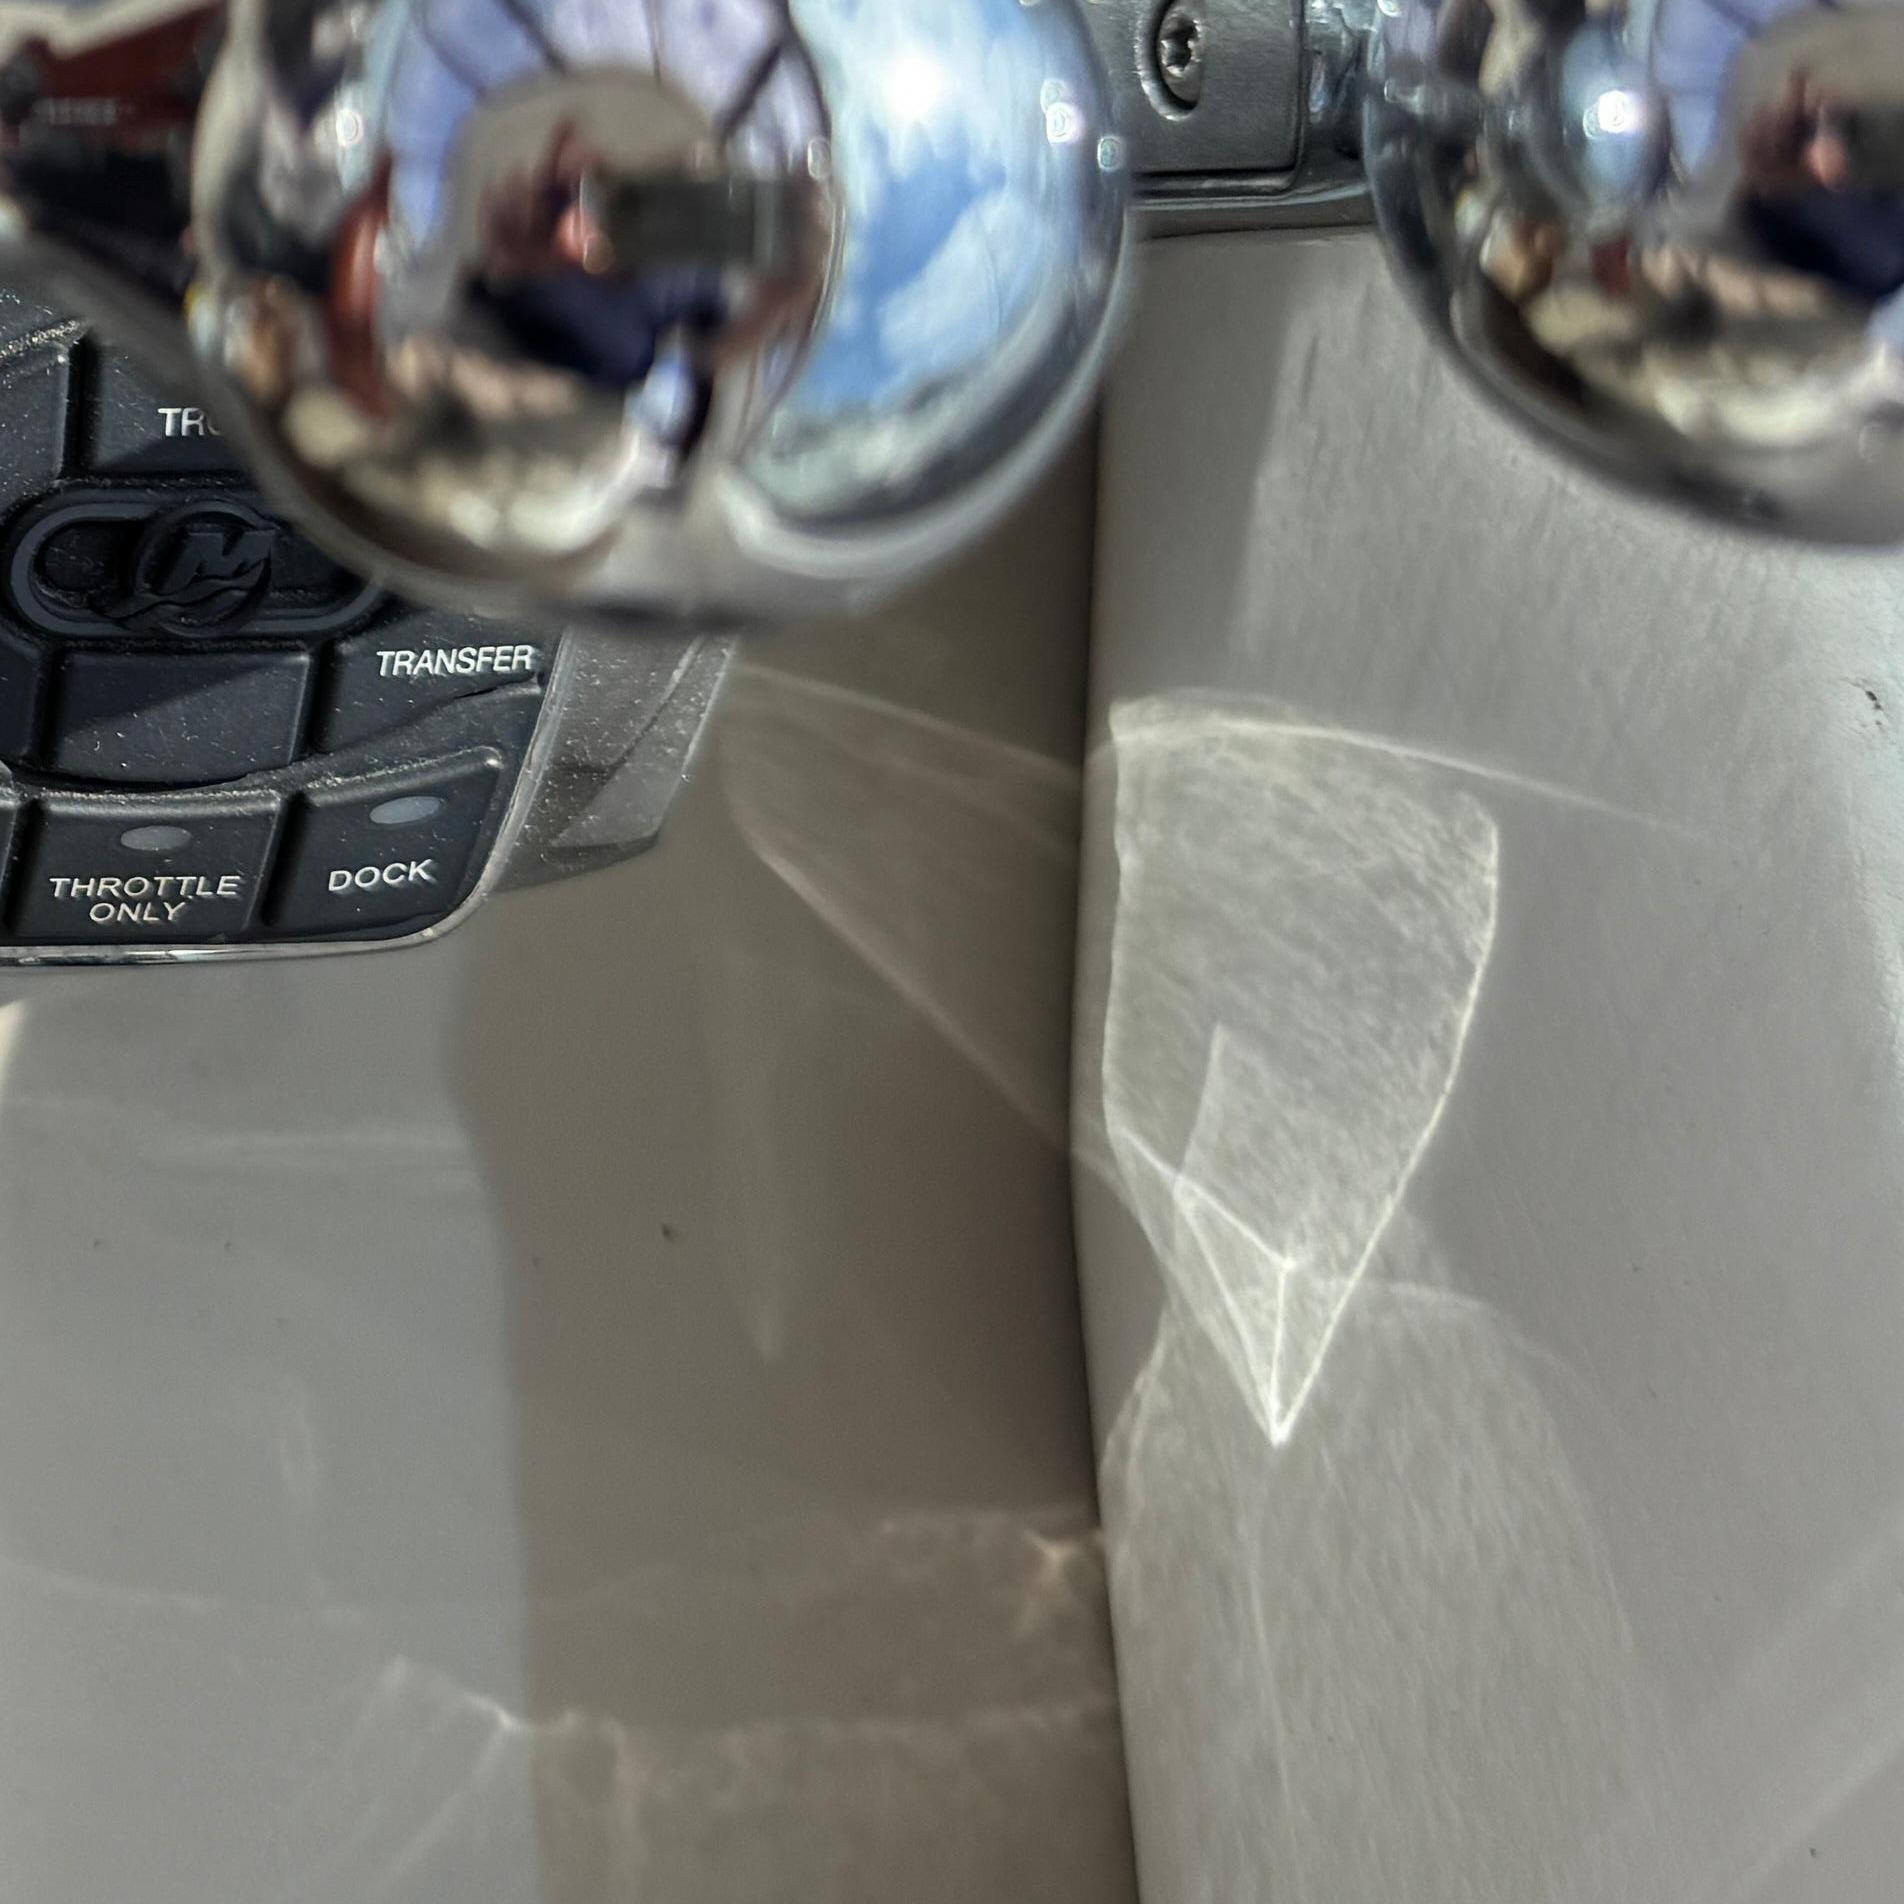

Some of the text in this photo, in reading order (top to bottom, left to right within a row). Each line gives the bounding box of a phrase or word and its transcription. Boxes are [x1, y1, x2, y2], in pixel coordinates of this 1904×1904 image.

[376, 645, 535, 680] TRANSFER
[49, 875, 243, 899] THROTTLE
[328, 859, 436, 893] DOCK
[89, 902, 186, 923] ONLY
